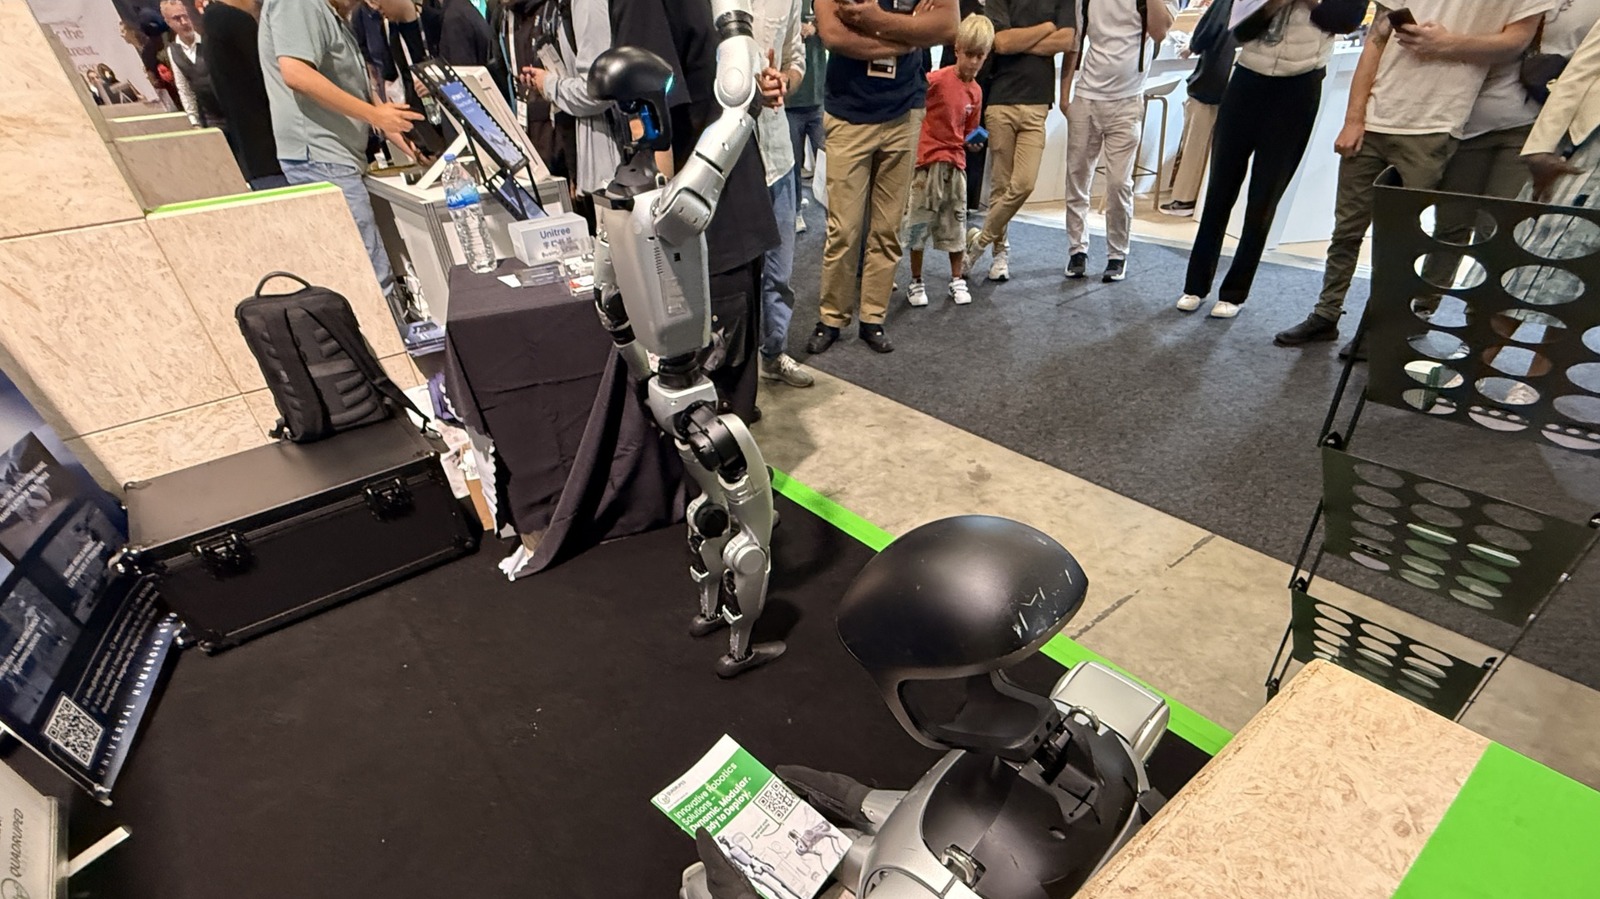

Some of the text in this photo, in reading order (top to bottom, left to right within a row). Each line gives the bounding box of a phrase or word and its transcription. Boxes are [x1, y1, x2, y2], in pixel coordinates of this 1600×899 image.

[66, 46, 99, 56] treet.
[540, 227, 571, 239] Unitree
[97, 704, 136, 776] UNIVERSAL
[132, 639, 164, 697] HUMANOID
[674, 791, 709, 819] Innovative
[706, 762, 738, 793] Robotics
[719, 776, 752, 808] Modular.
[682, 800, 712, 826] Solutions
[706, 819, 721, 833] ady
[717, 813, 727, 821] to
[9, 807, 24, 878] QUADRUPED
